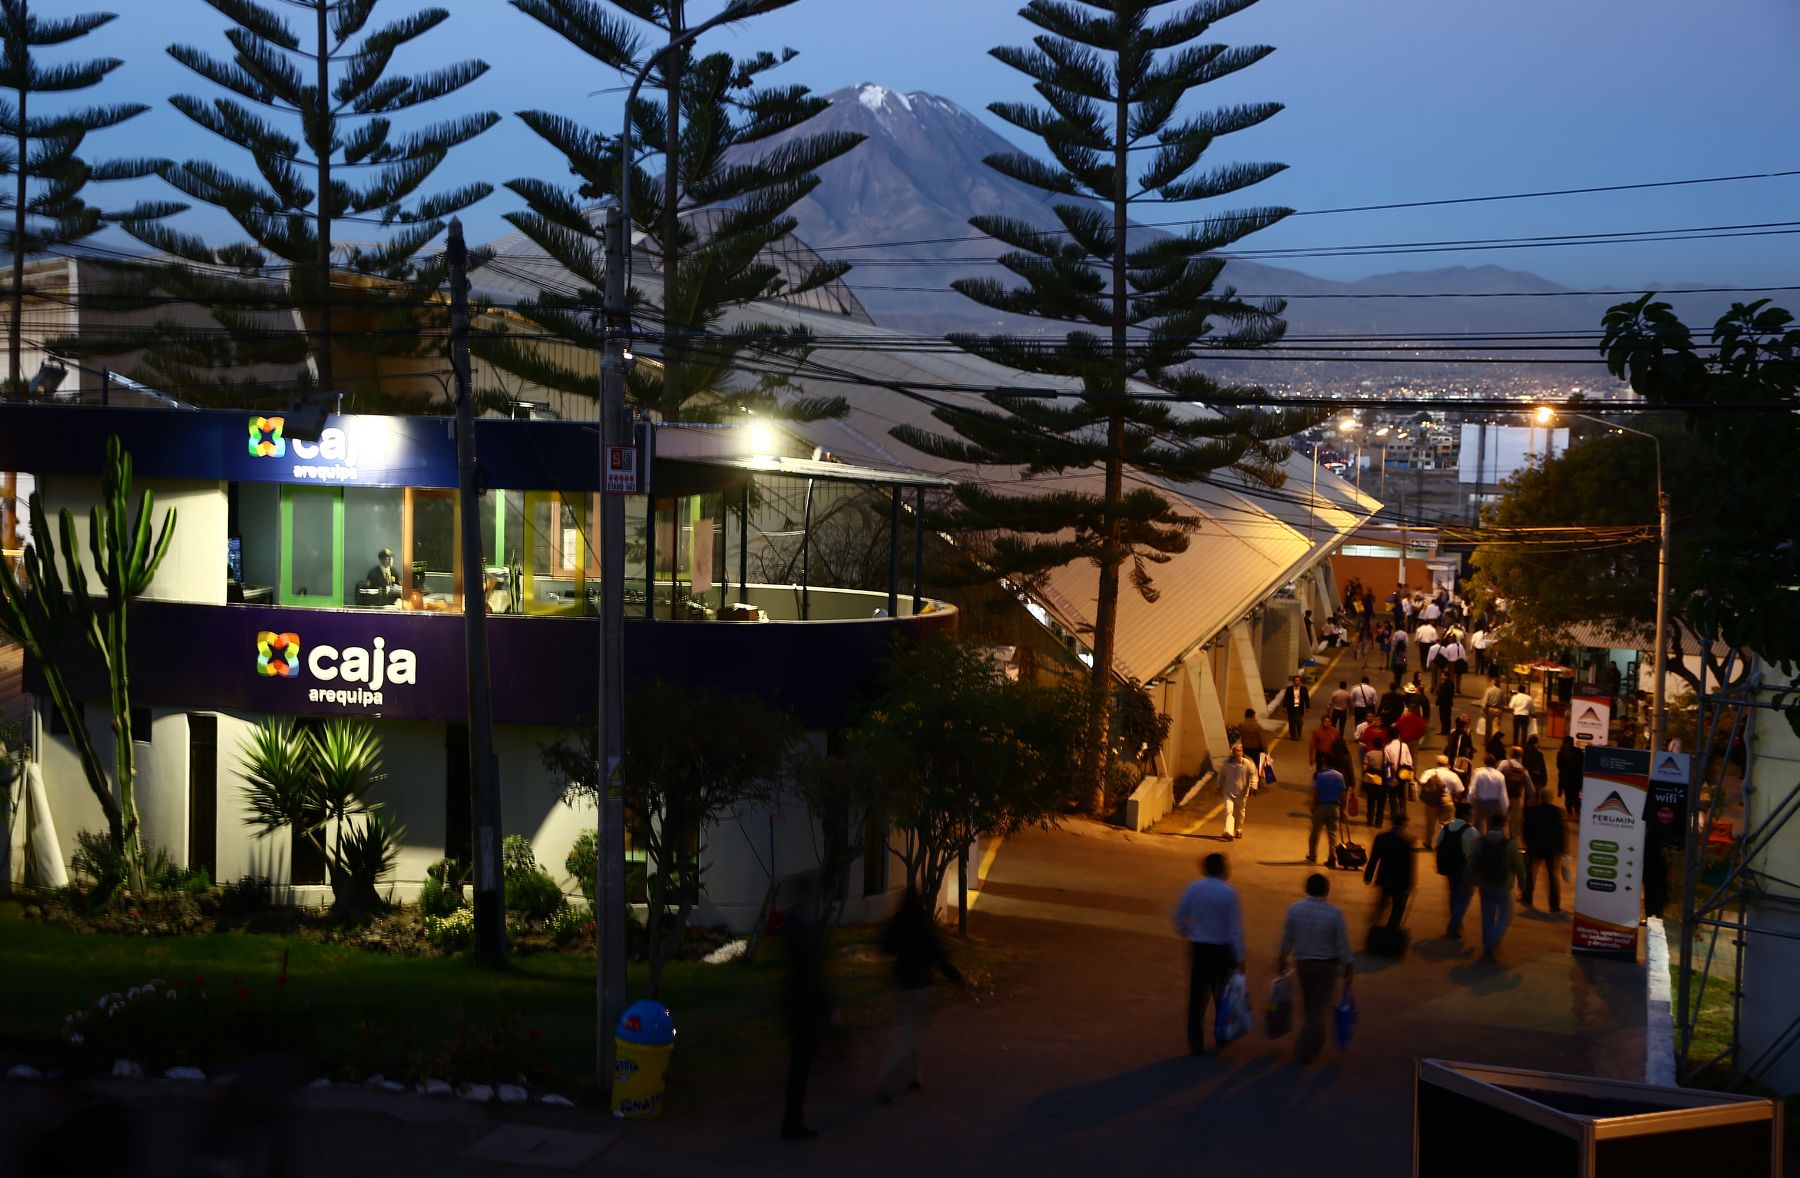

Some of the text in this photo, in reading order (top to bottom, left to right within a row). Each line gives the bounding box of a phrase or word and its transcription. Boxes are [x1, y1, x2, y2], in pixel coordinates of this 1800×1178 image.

[293, 463, 359, 483] arequipa
[307, 636, 417, 691] caja
[308, 687, 384, 707] arequipa
[1654, 792, 1678, 804] wifi
[1592, 814, 1636, 825] PERUMIN
